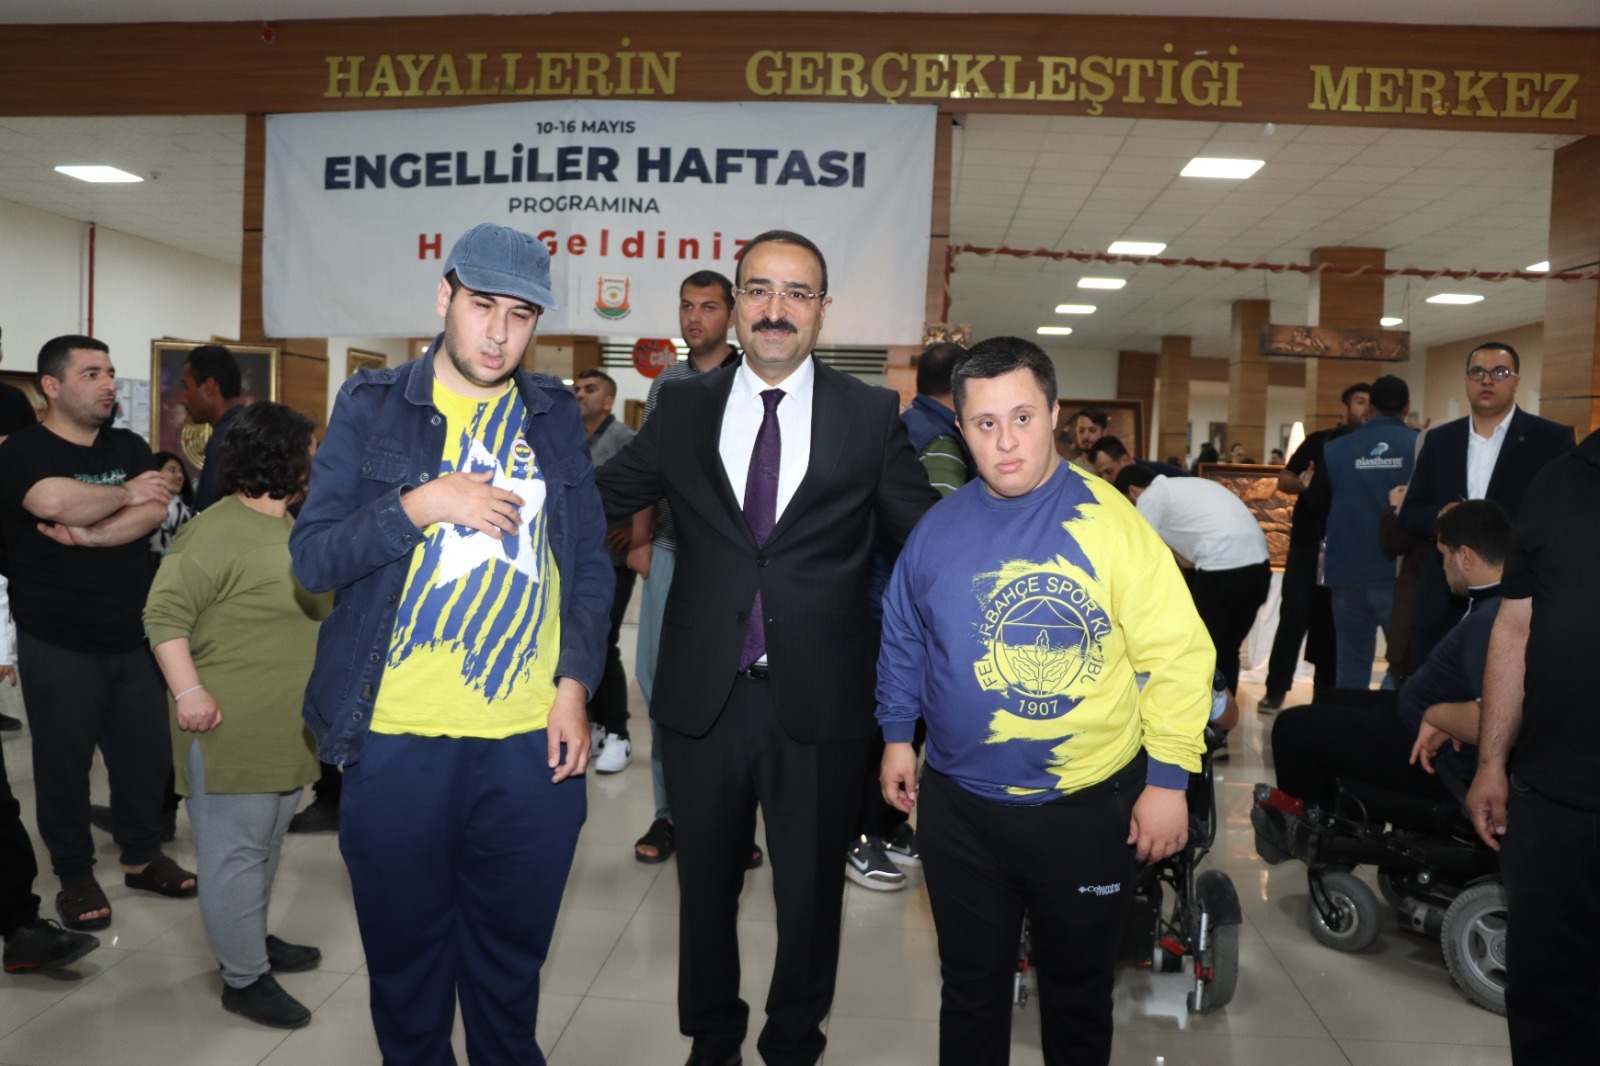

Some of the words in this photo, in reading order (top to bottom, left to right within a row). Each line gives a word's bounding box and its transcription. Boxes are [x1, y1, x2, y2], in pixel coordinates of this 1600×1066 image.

[323, 37, 682, 99] HAYALLERİN
[1307, 64, 1579, 120] MERKEZ
[536, 120, 576, 135] 10-16
[581, 120, 636, 134] MAYIS
[636, 146, 867, 188] HAFTASI
[508, 195, 661, 214] PROGRAMINA
[978, 576, 1041, 688] FERBAHÇE
[1045, 576, 1097, 617] SPOR
[1018, 700, 1059, 716] 1907
